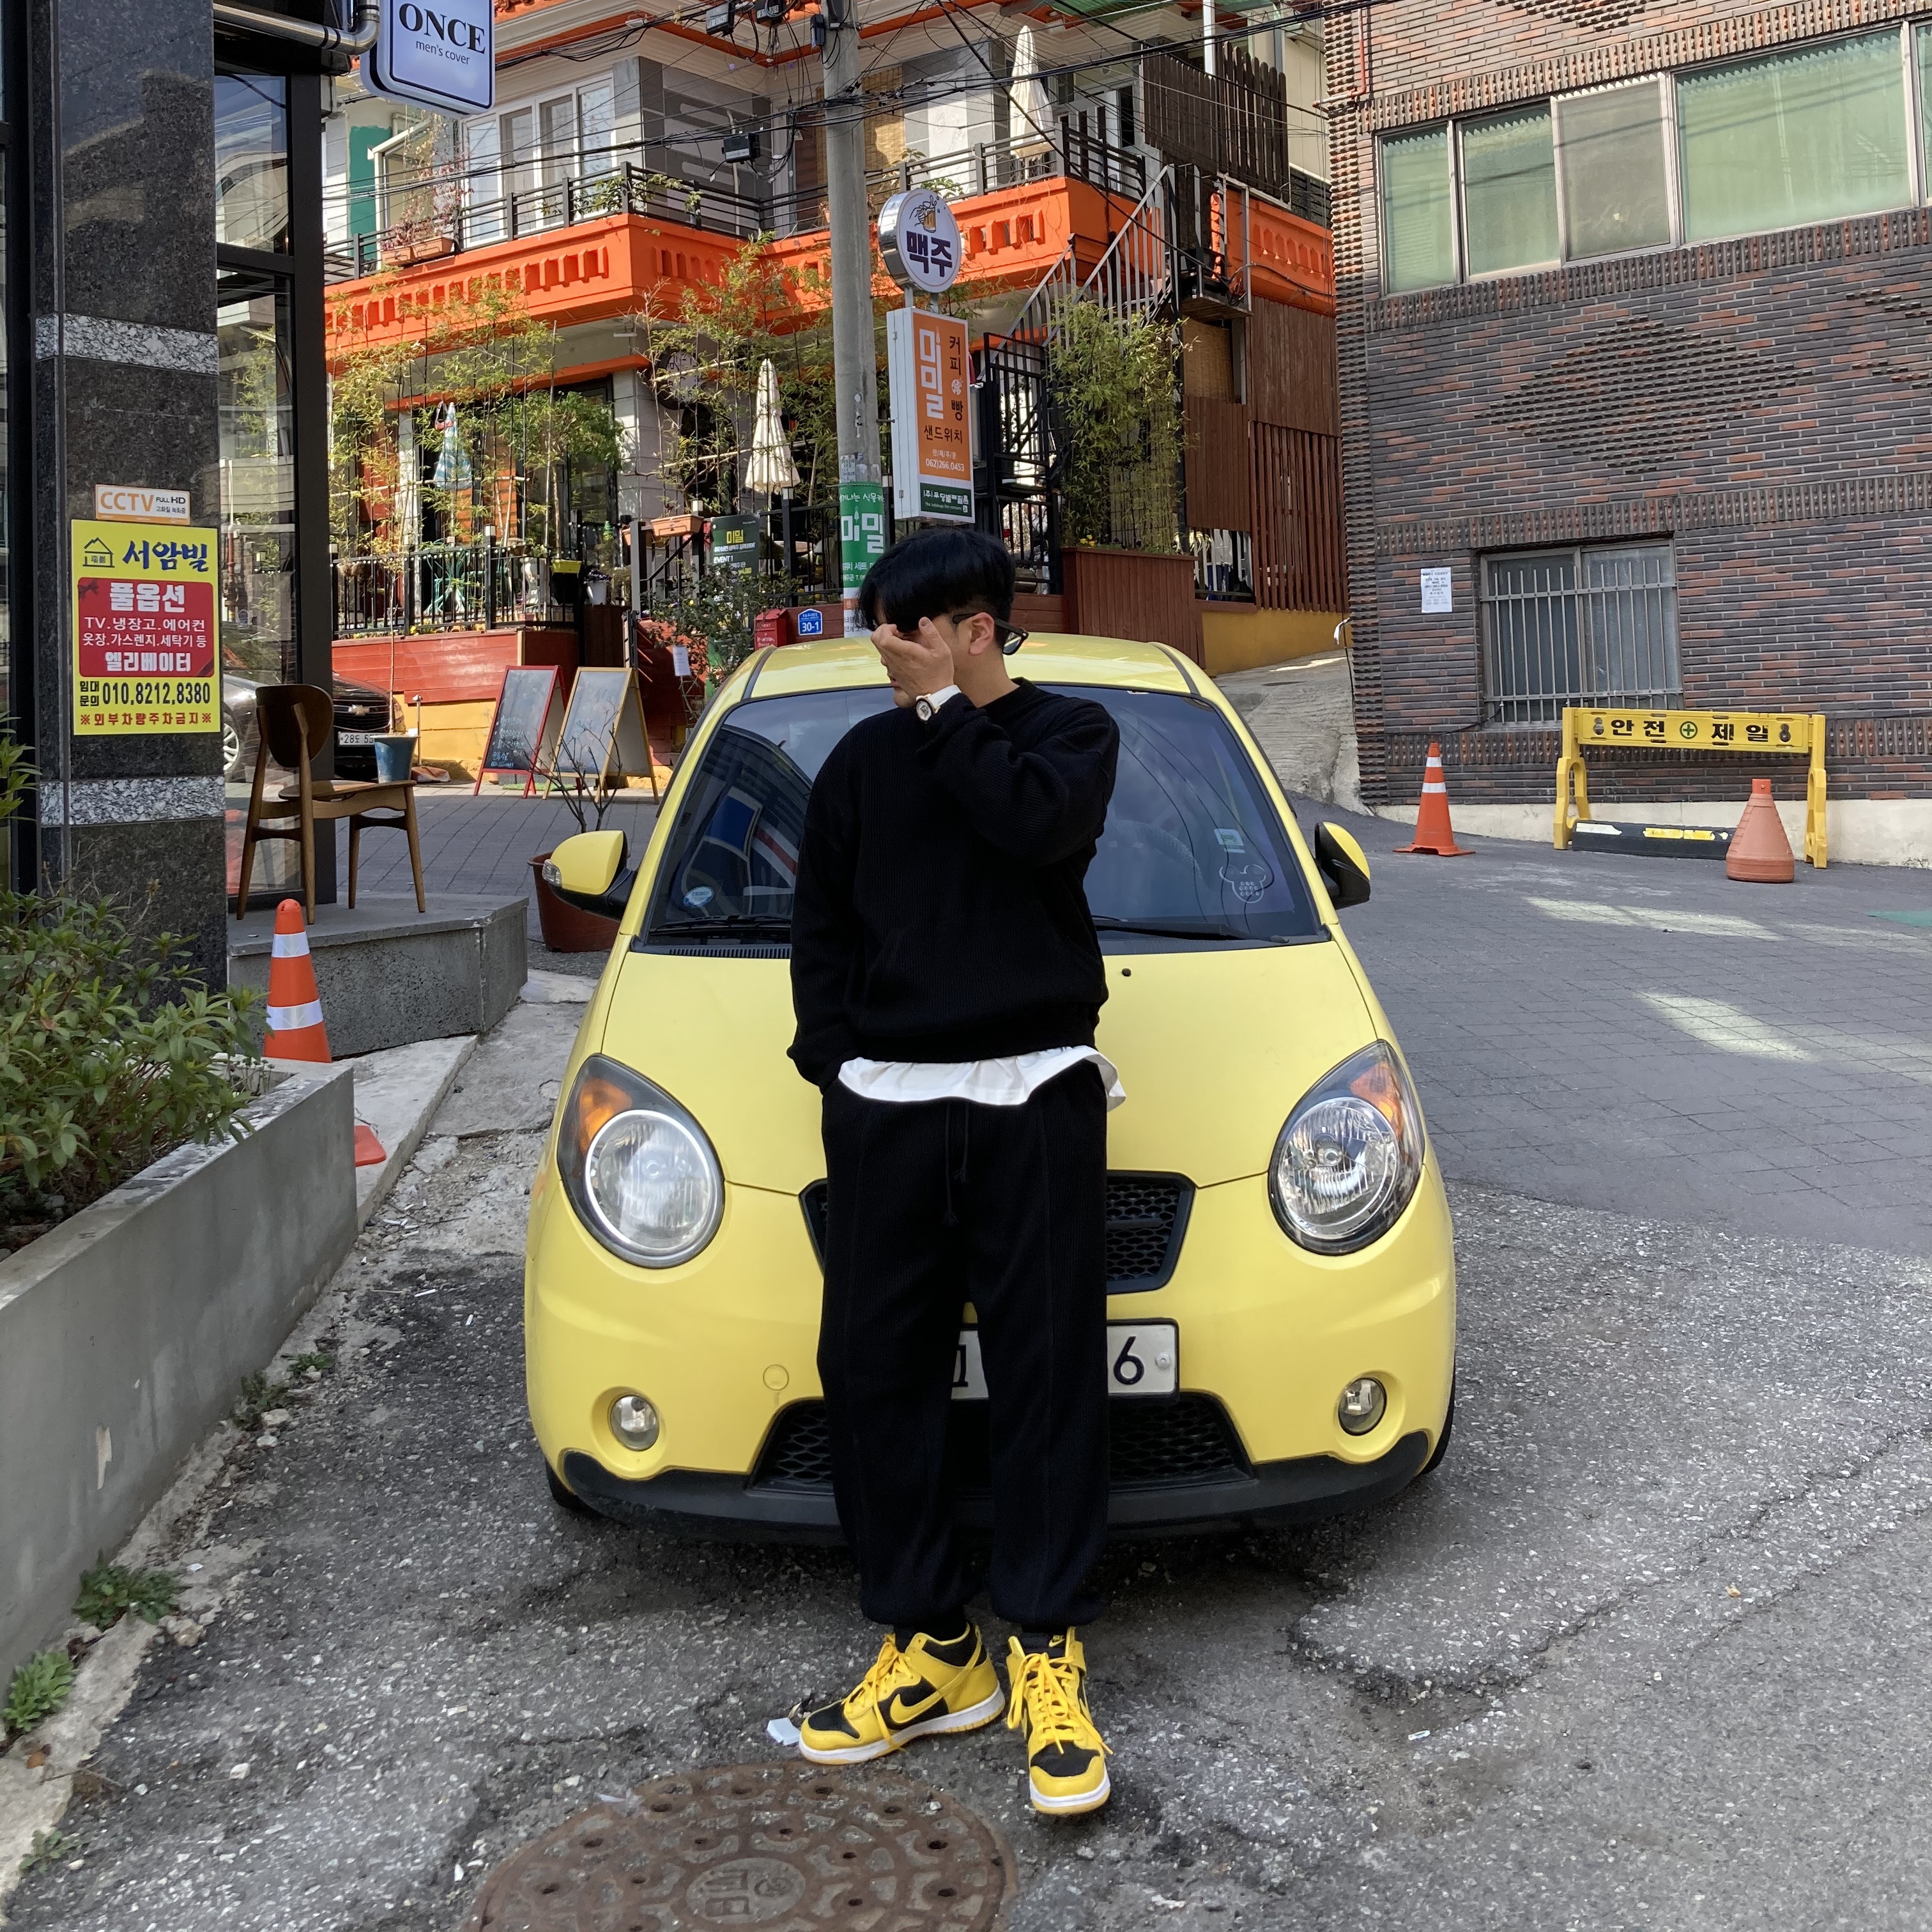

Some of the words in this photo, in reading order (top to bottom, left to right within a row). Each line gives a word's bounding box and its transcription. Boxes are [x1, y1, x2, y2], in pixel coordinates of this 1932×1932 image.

[399, 3, 486, 54] ONCE
[415, 40, 443, 56] men's
[445, 50, 471, 65] cover
[906, 230, 953, 277] 맥주
[949, 335, 962, 376] 커피
[951, 399, 963, 421] 빵
[924, 424, 963, 444] 샌드위치
[100, 491, 155, 512] CCTV
[171, 496, 186, 504] HD
[122, 540, 209, 572] 서암빌
[109, 581, 186, 613] 풀옵션
[84, 617, 205, 632] TV.냉장고.에어컨
[801, 621, 819, 632] 30-1
[195, 635, 207, 648] 등
[105, 652, 191, 672] 엘리베이터
[79, 680, 100, 693] 임대
[79, 694, 100, 707] 문의
[1610, 718, 1666, 738] 안전
[1711, 722, 1770, 743] 제일
